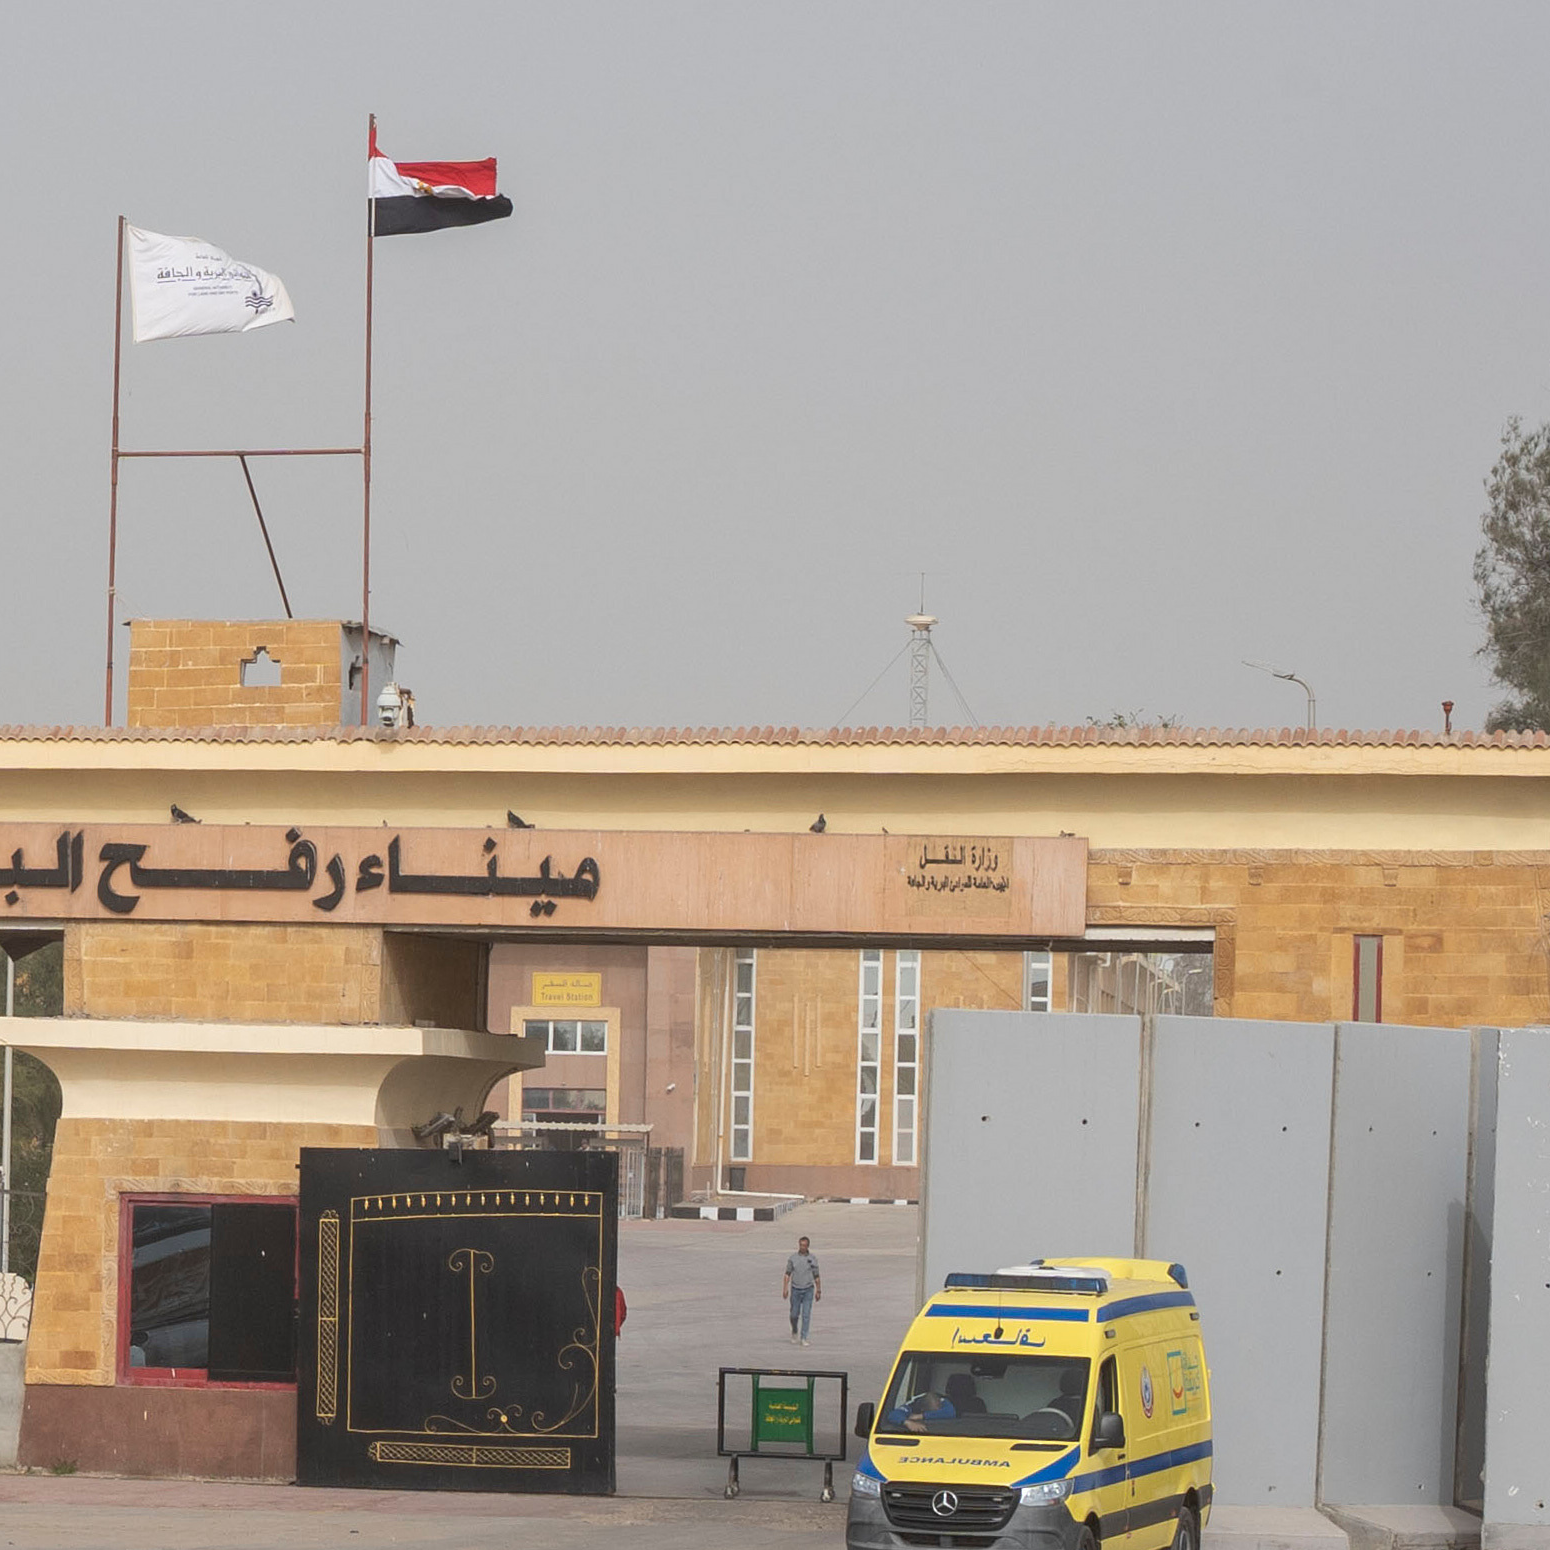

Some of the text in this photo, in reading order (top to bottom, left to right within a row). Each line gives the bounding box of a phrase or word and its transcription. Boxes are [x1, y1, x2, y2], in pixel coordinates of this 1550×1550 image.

[100, 827, 346, 912] رفح
[357, 836, 601, 917] ميناء
[920, 844, 999, 872] وزارة النقل
[541, 992, 594, 1001] Travel Station
